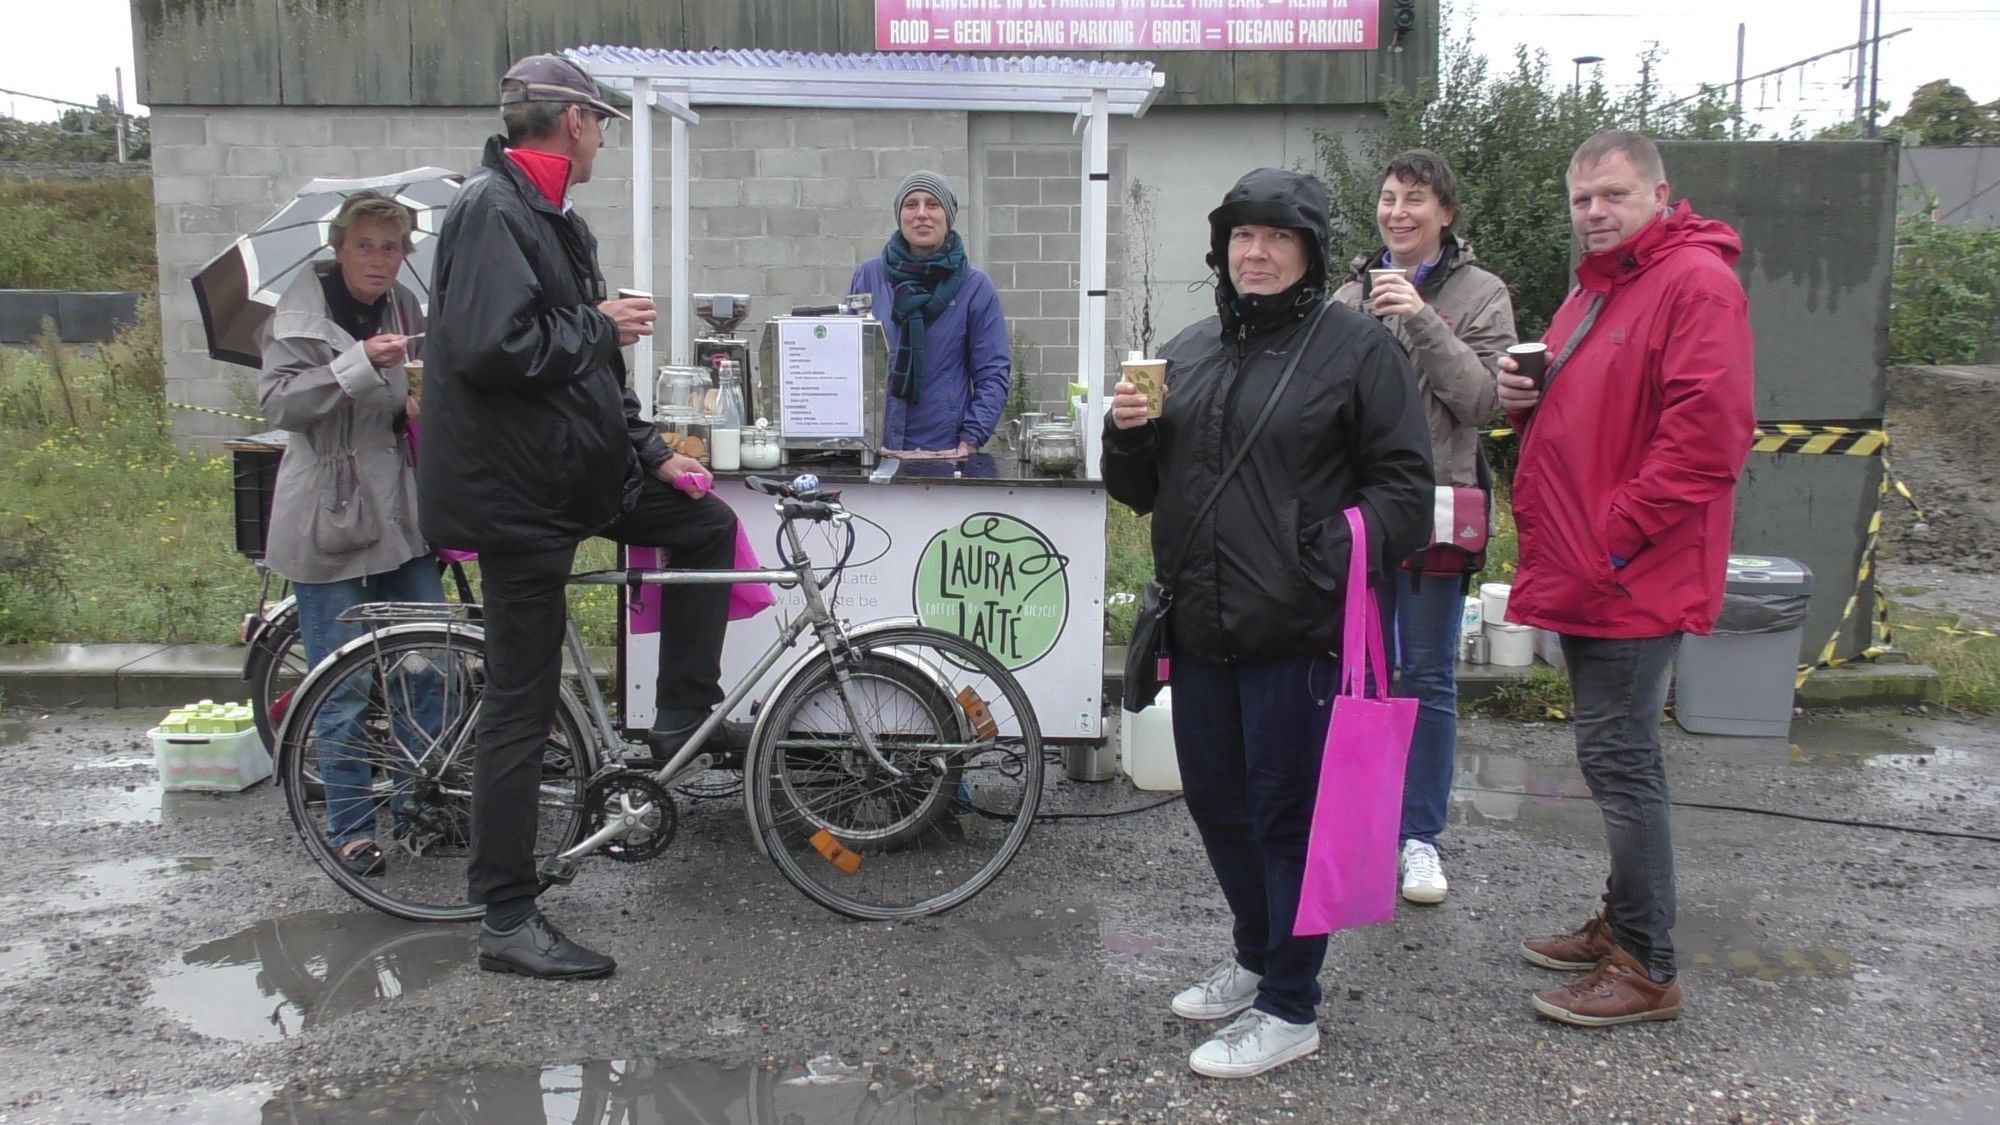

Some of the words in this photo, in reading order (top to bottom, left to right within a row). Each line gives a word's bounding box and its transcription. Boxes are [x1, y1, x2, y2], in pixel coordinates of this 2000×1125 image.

[890, 19, 929, 44] ROOD
[934, 28, 949, 39] =
[954, 19, 991, 44] GEEN
[997, 19, 1065, 44] TOEGANG
[1070, 19, 1134, 44] PARKING
[1138, 20, 1147, 43] /
[1152, 19, 1201, 44] GROEN
[1206, 28, 1221, 39] =
[1226, 19, 1294, 44] TOEGANG
[1299, 19, 1363, 43] PARKING
[940, 540, 1016, 598] LAURA
[925, 602, 956, 616] COFFEE
[1023, 604, 1057, 618] BICYCLE
[958, 601, 1022, 659] LATTÉ
